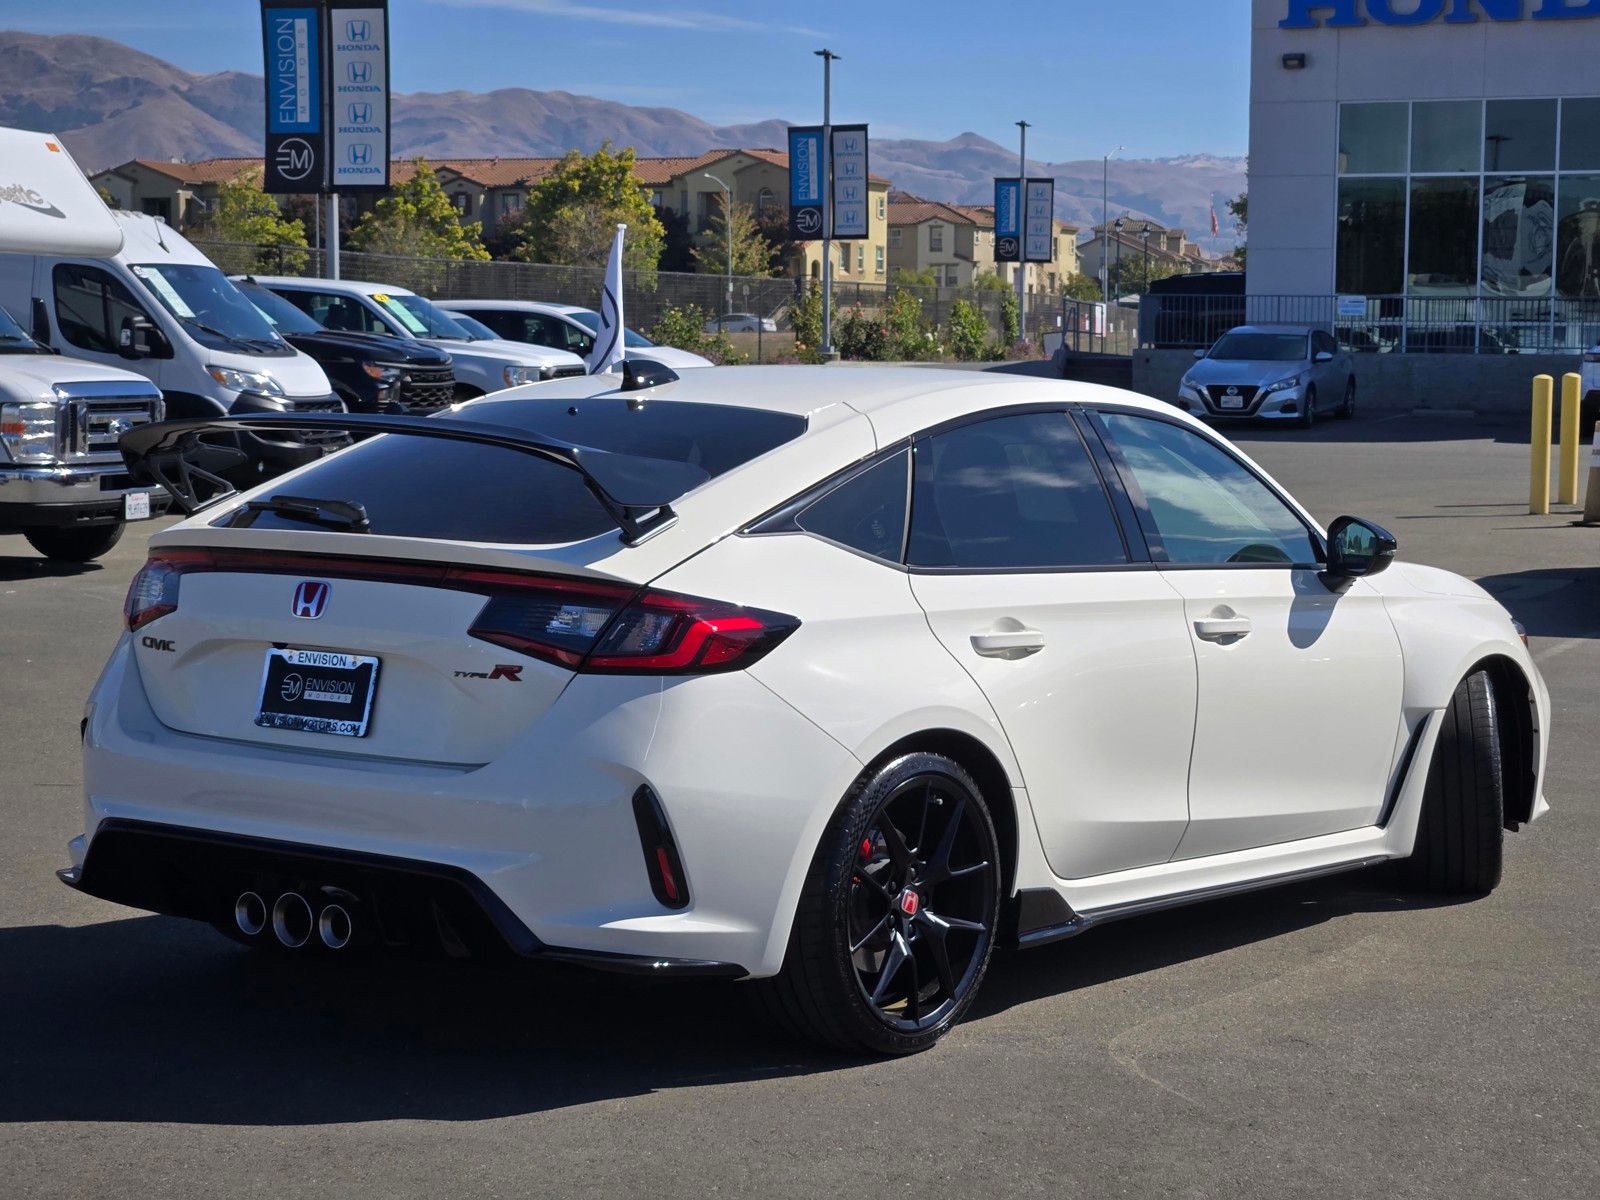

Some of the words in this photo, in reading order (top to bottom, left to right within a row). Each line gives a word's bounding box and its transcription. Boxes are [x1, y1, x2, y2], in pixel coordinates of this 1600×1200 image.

[276, 18, 296, 123] ENVISION
[297, 28, 307, 114] MOTORS
[338, 126, 382, 134] HONDA
[798, 138, 810, 200] ENVISION
[142, 636, 176, 652] CIVIC
[298, 652, 347, 667] ENVISION
[488, 664, 523, 682] R
[305, 677, 355, 694] ENVISION
[307, 693, 349, 701] MOTORS
